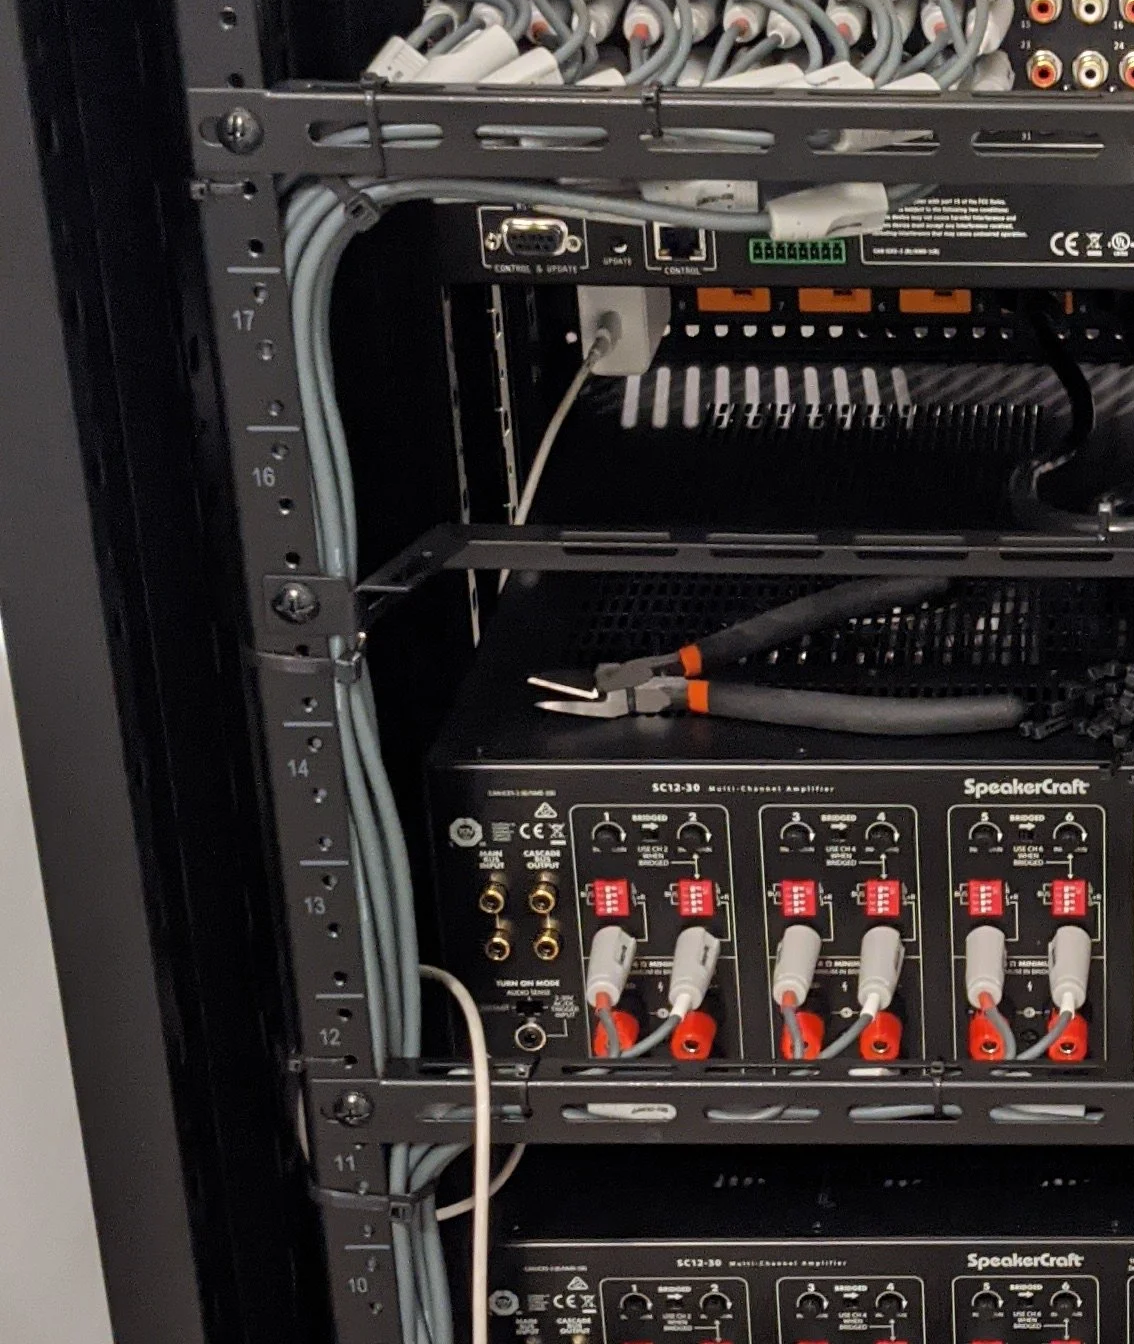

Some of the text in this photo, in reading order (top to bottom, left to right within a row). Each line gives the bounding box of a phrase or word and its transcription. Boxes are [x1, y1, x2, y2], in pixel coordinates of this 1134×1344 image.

[603, 257, 632, 266] UPDATE
[494, 263, 532, 274] CONTROL
[546, 264, 578, 274] UPDATE
[664, 266, 702, 276] CONTROL
[233, 310, 254, 330] 17
[253, 467, 275, 486] 16
[288, 759, 308, 777] 14
[652, 782, 835, 794] SC12-30 Multi-Channel Amplifier
[964, 778, 1089, 797] SpeakerCraft
[603, 812, 610, 821] 1
[688, 812, 697, 821] 2
[792, 812, 801, 821] 3
[877, 812, 886, 821] 4
[981, 812, 990, 821] 5
[1065, 812, 1074, 821] 6
[305, 897, 325, 914] 13
[320, 1028, 340, 1045] 12
[335, 1155, 354, 1171] 11
[676, 1259, 722, 1267] SC12-30
[967, 1253, 1084, 1270] SpeakerCraft
[349, 1278, 367, 1292] 10
